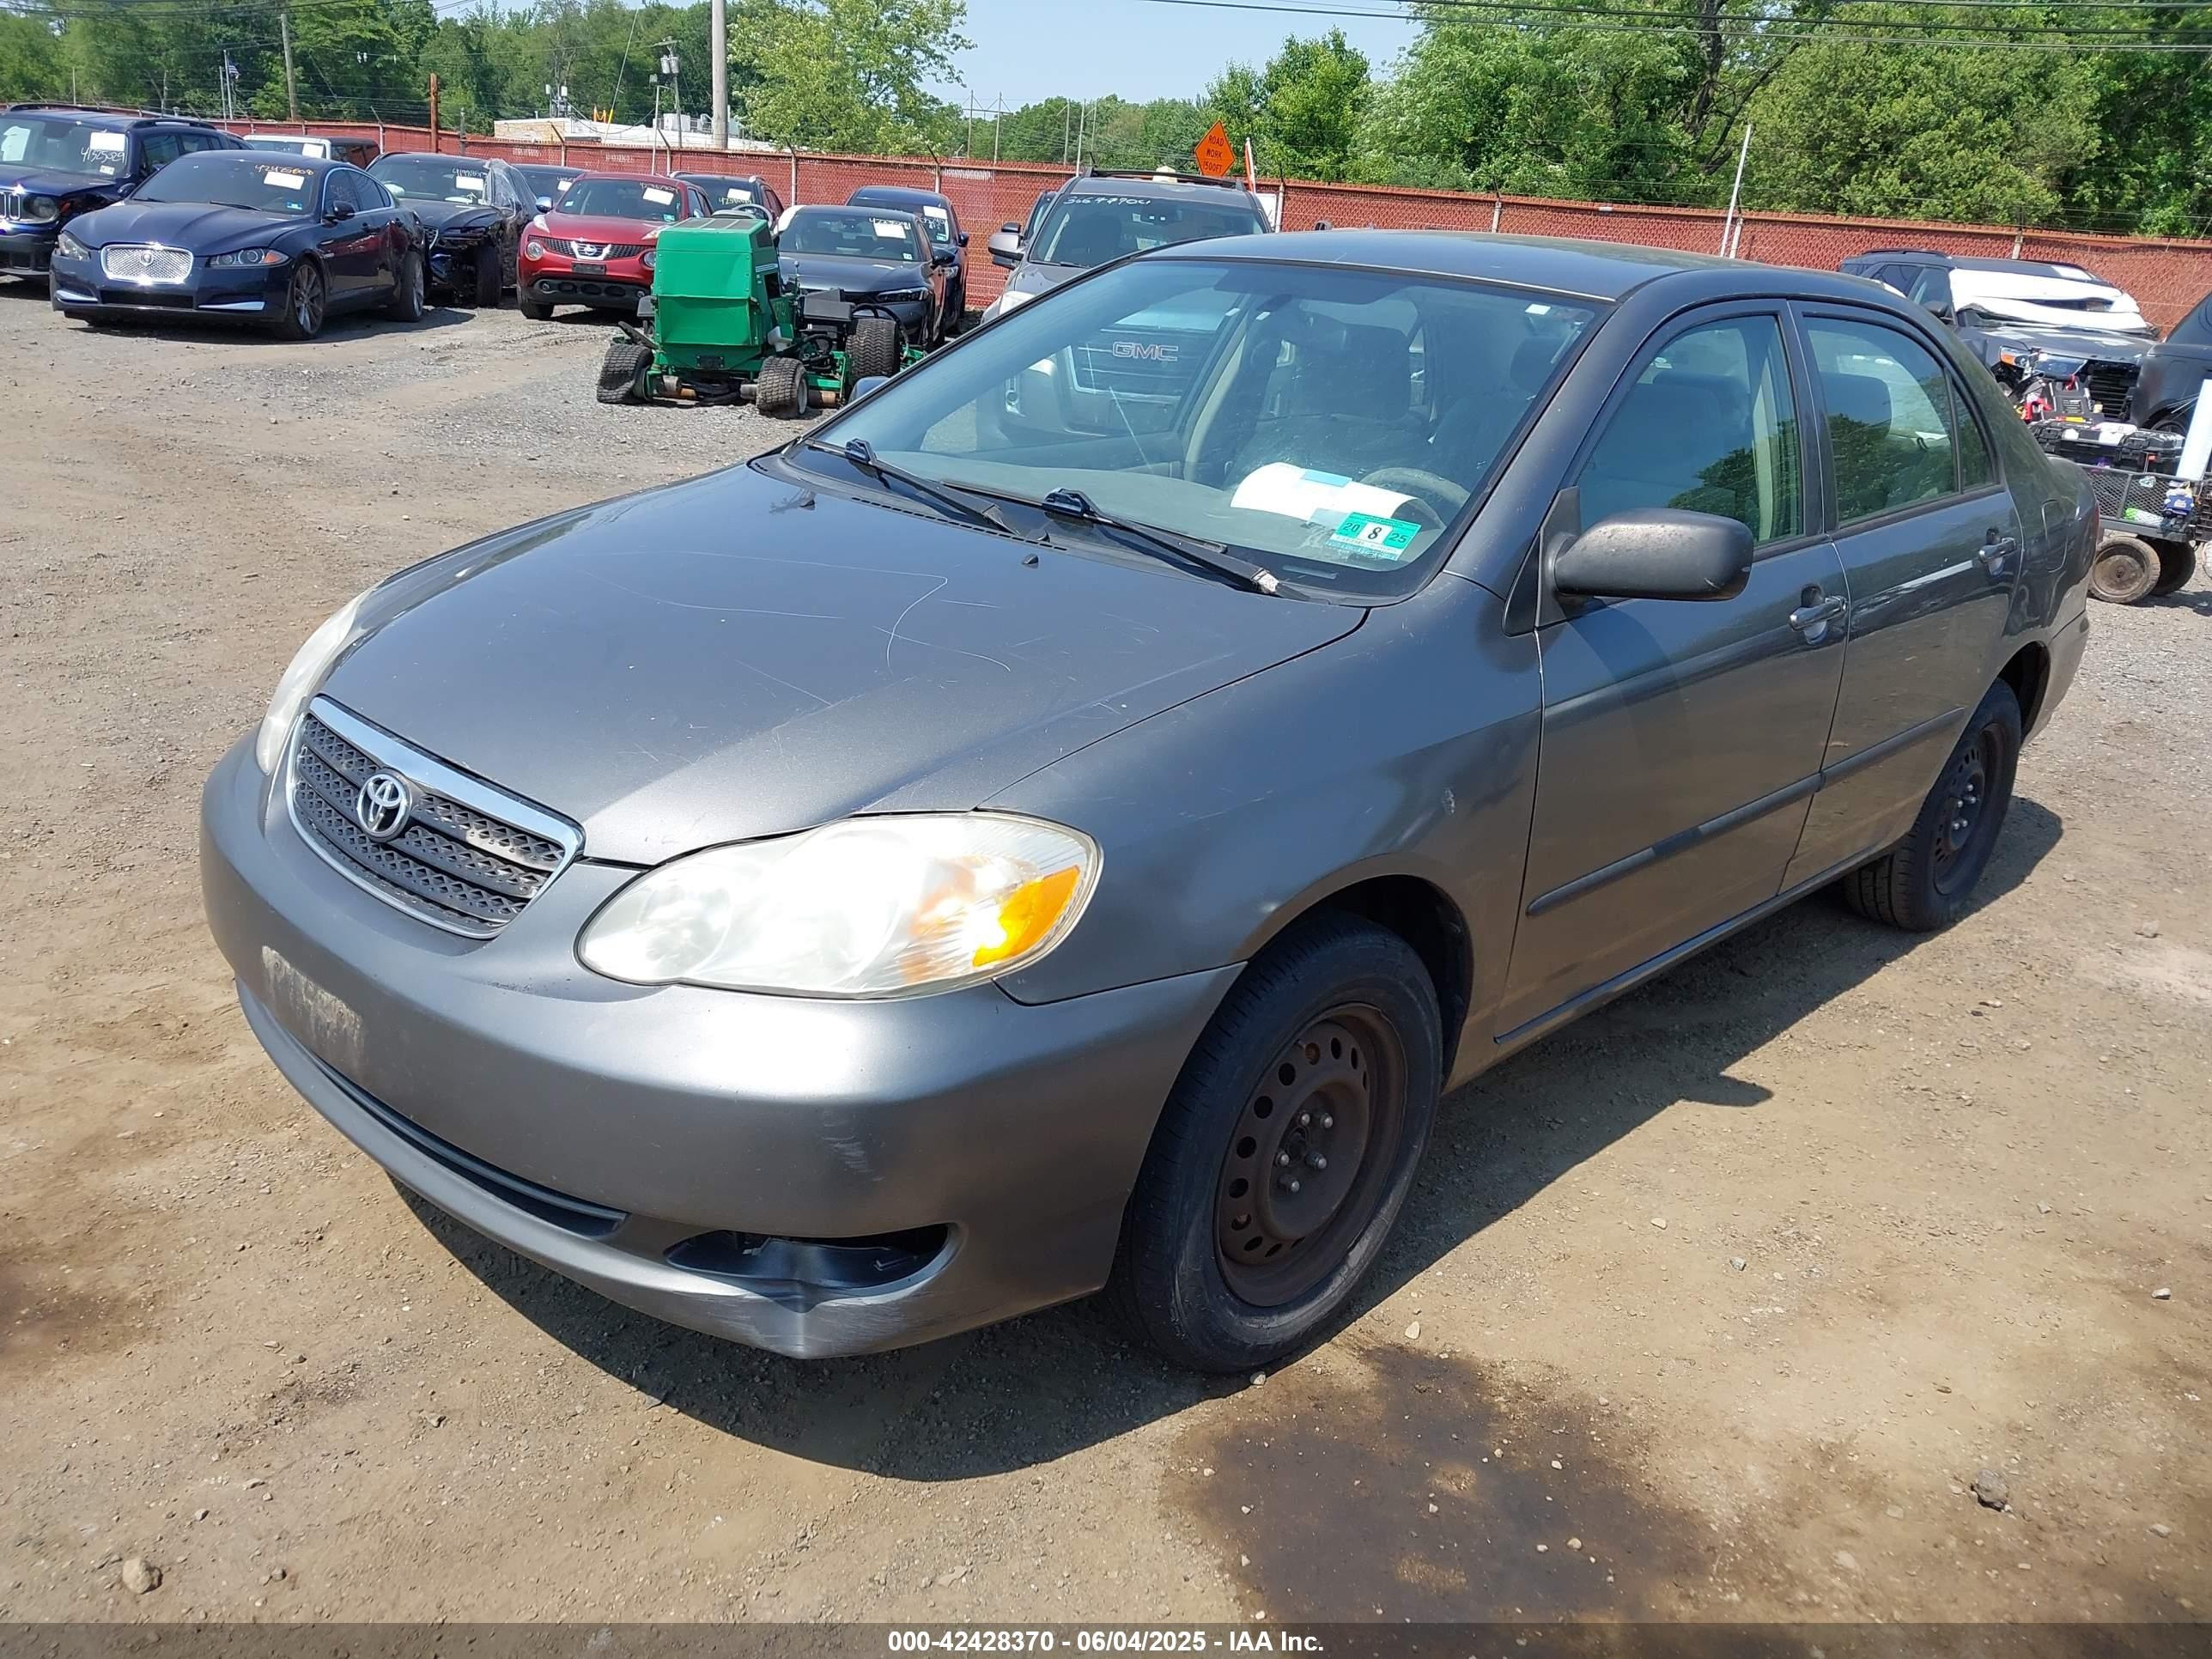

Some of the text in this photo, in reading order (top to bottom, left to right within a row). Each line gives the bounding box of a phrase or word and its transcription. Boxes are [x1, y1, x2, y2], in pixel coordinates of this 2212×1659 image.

[1208, 135, 1224, 147] ROAD
[1206, 149, 1223, 159] WORK
[1113, 342, 1178, 362] GMC
[1342, 522, 1407, 544] 20 8 25
